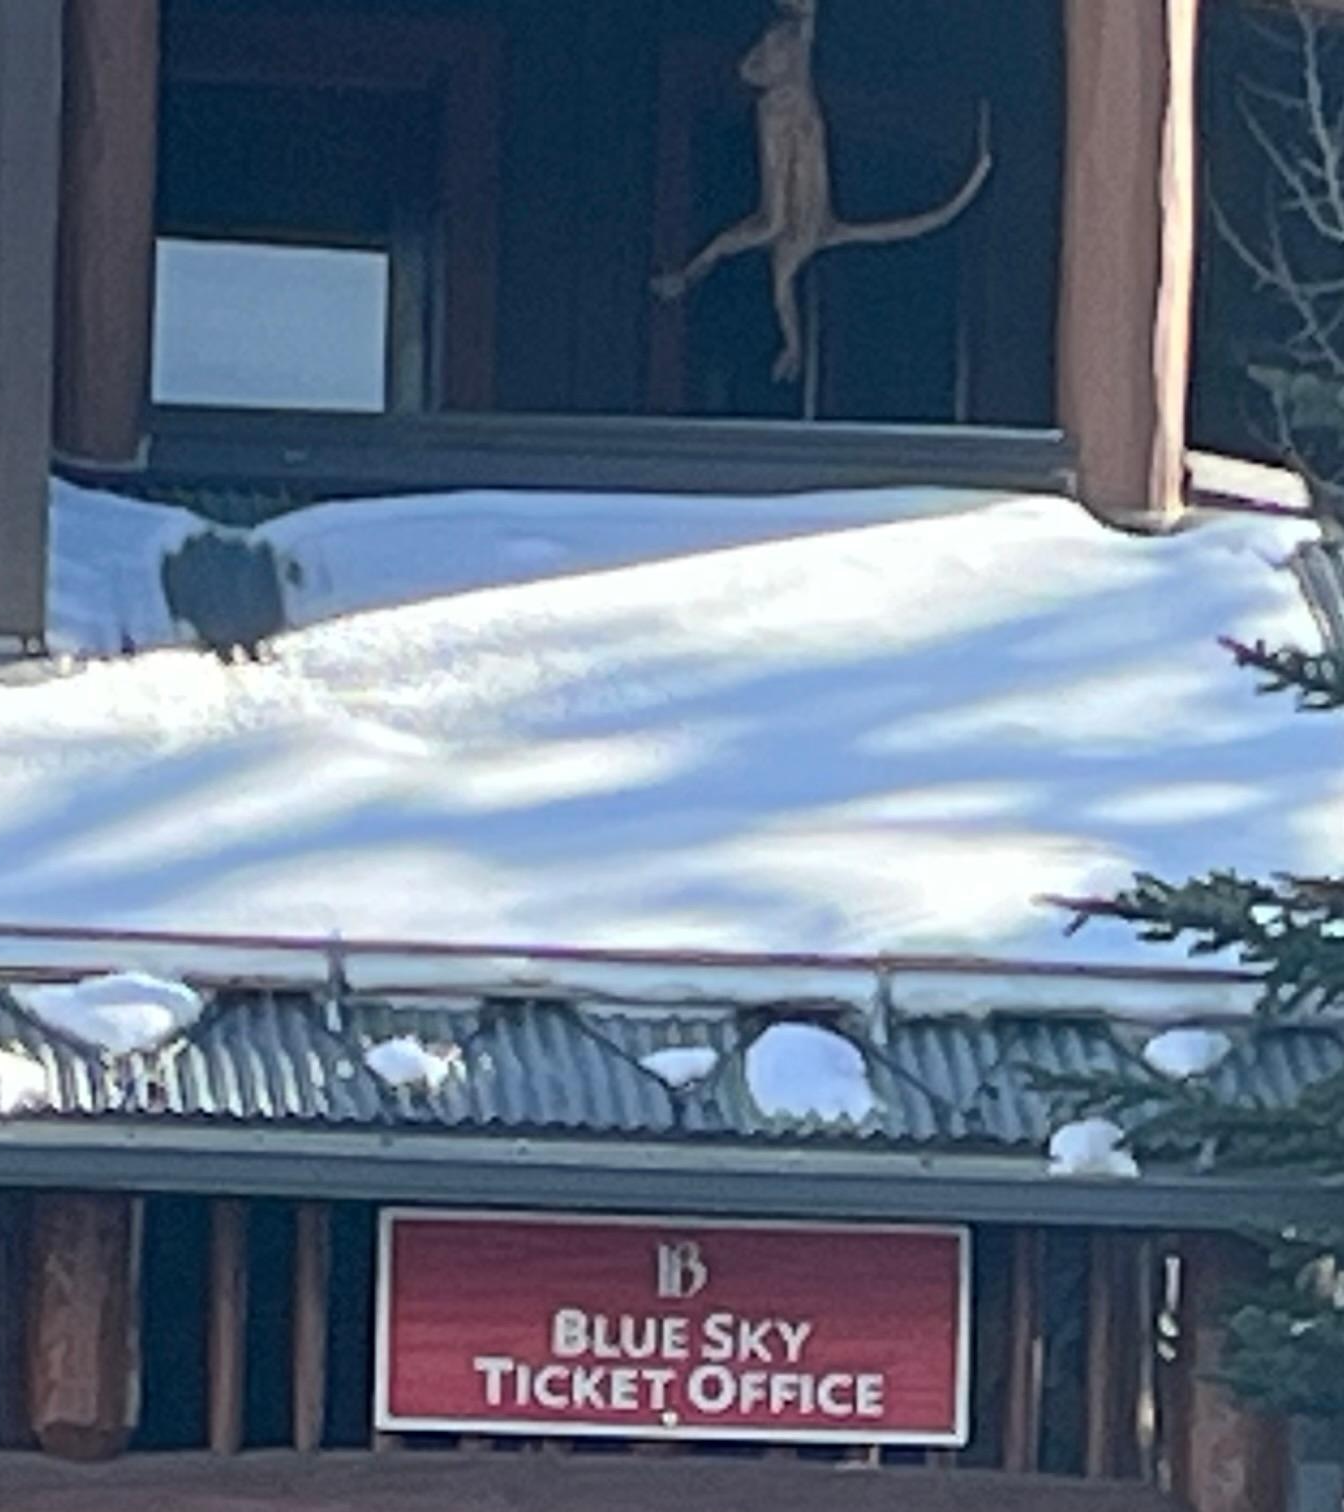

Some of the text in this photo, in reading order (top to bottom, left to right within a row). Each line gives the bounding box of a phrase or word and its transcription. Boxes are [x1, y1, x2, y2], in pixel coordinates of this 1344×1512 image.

[553, 1308, 811, 1363] BLUE SKY
[474, 1357, 884, 1416] TICKET OFFICE
